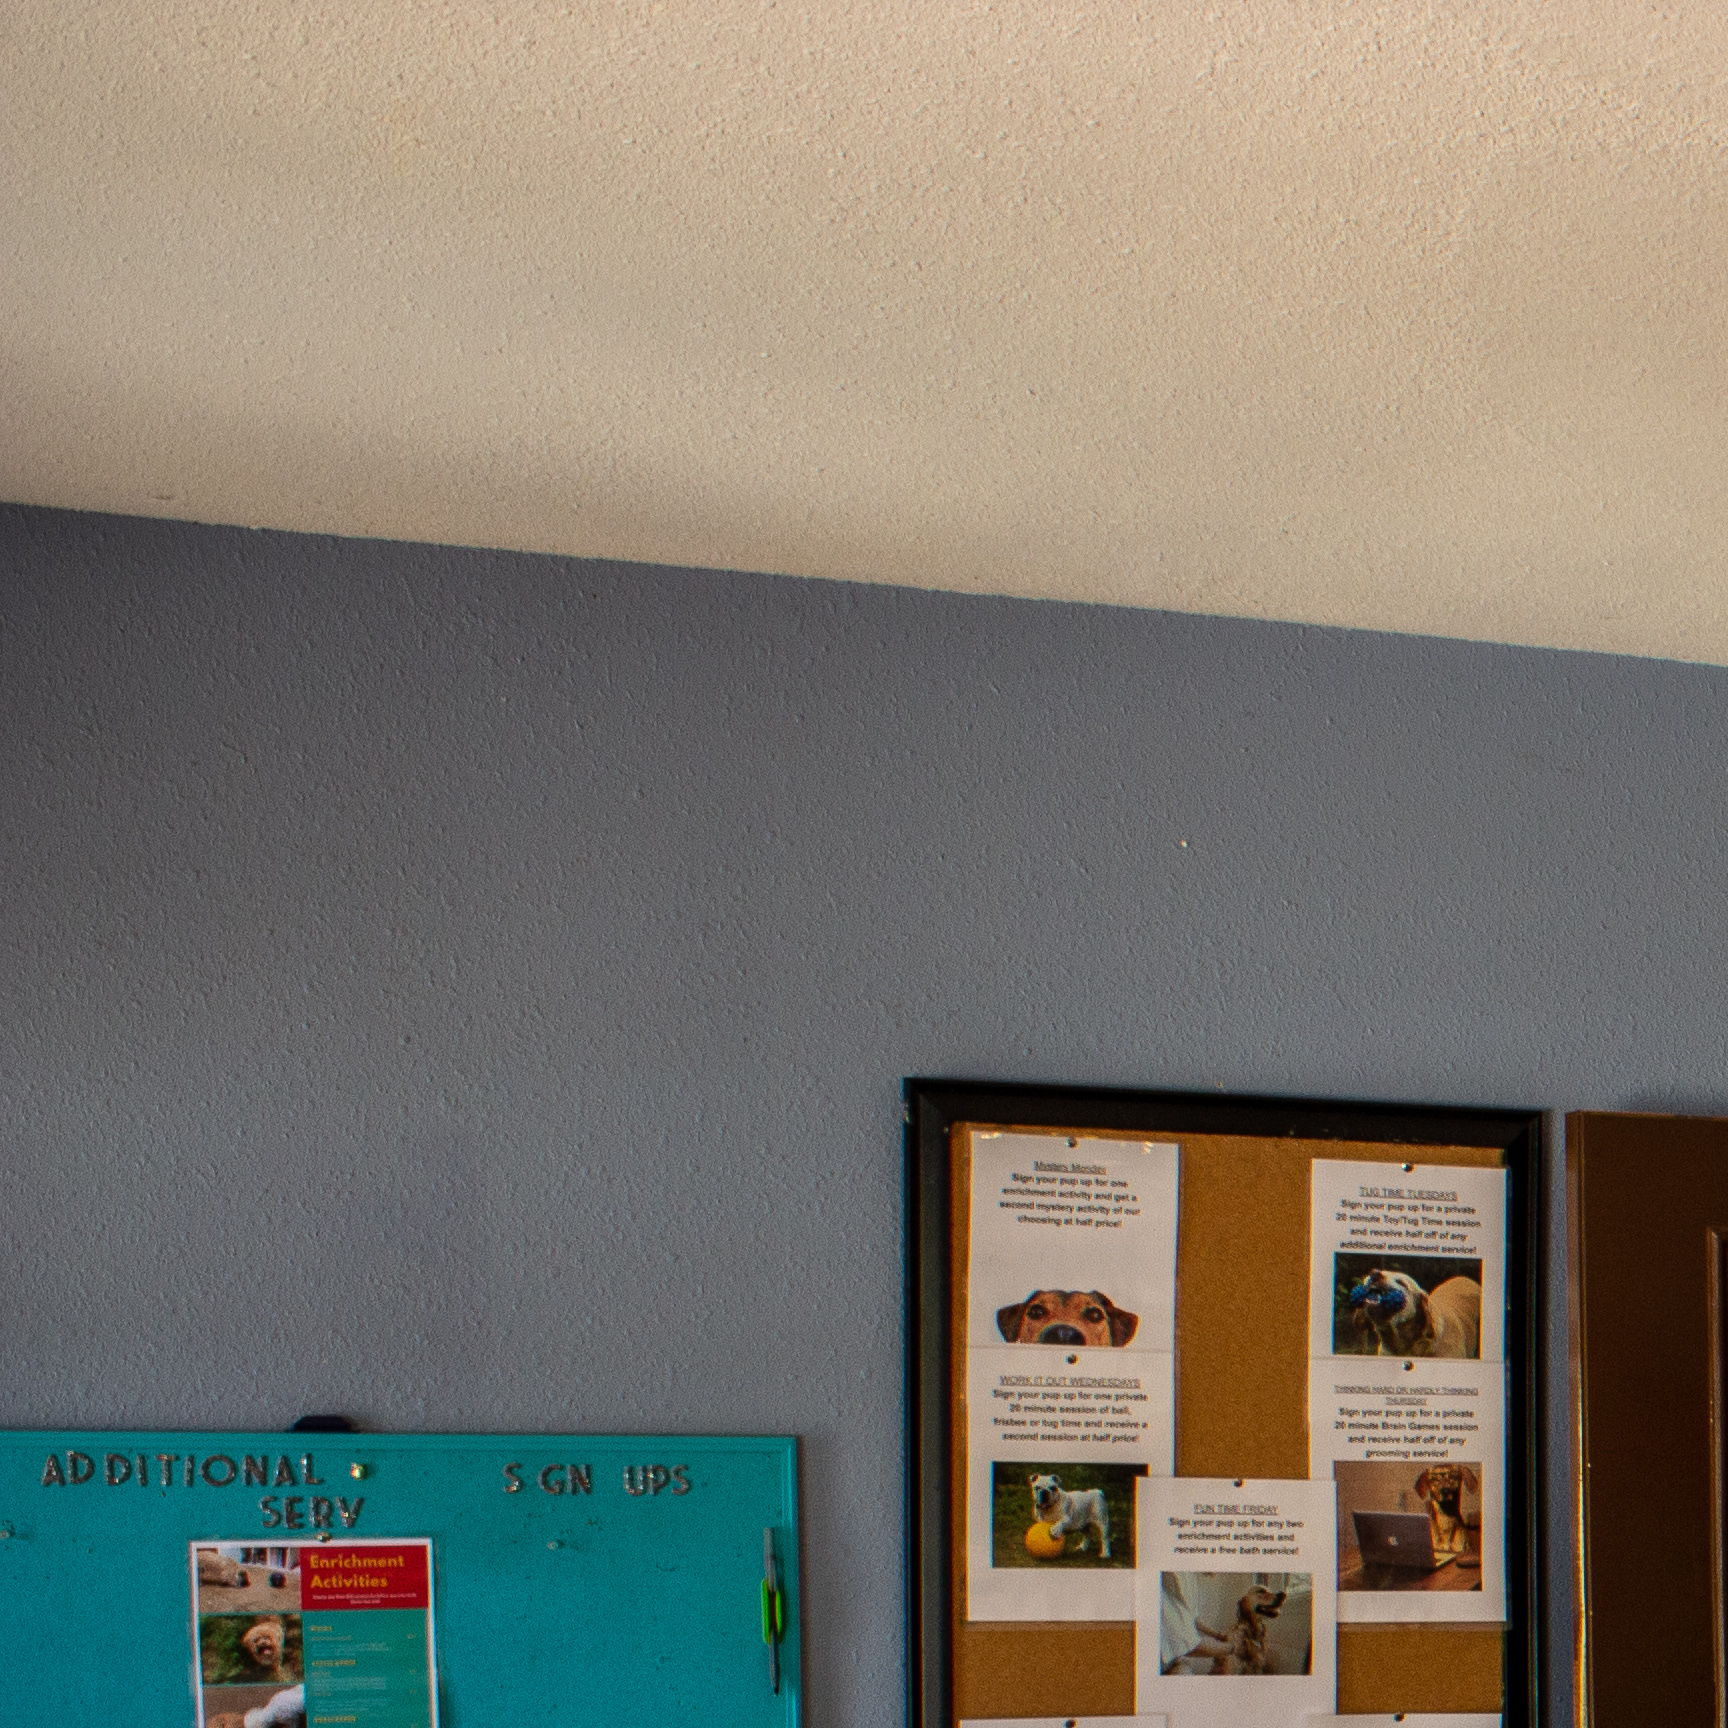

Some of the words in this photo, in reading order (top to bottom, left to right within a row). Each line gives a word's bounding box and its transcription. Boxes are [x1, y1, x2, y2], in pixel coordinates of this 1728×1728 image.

[41, 1450, 324, 1488] ADDITIONAL
[623, 1464, 691, 1496] UPS
[258, 1496, 364, 1529] SERV
[309, 1554, 404, 1569] Enrichment
[310, 1574, 388, 1588] Activities
